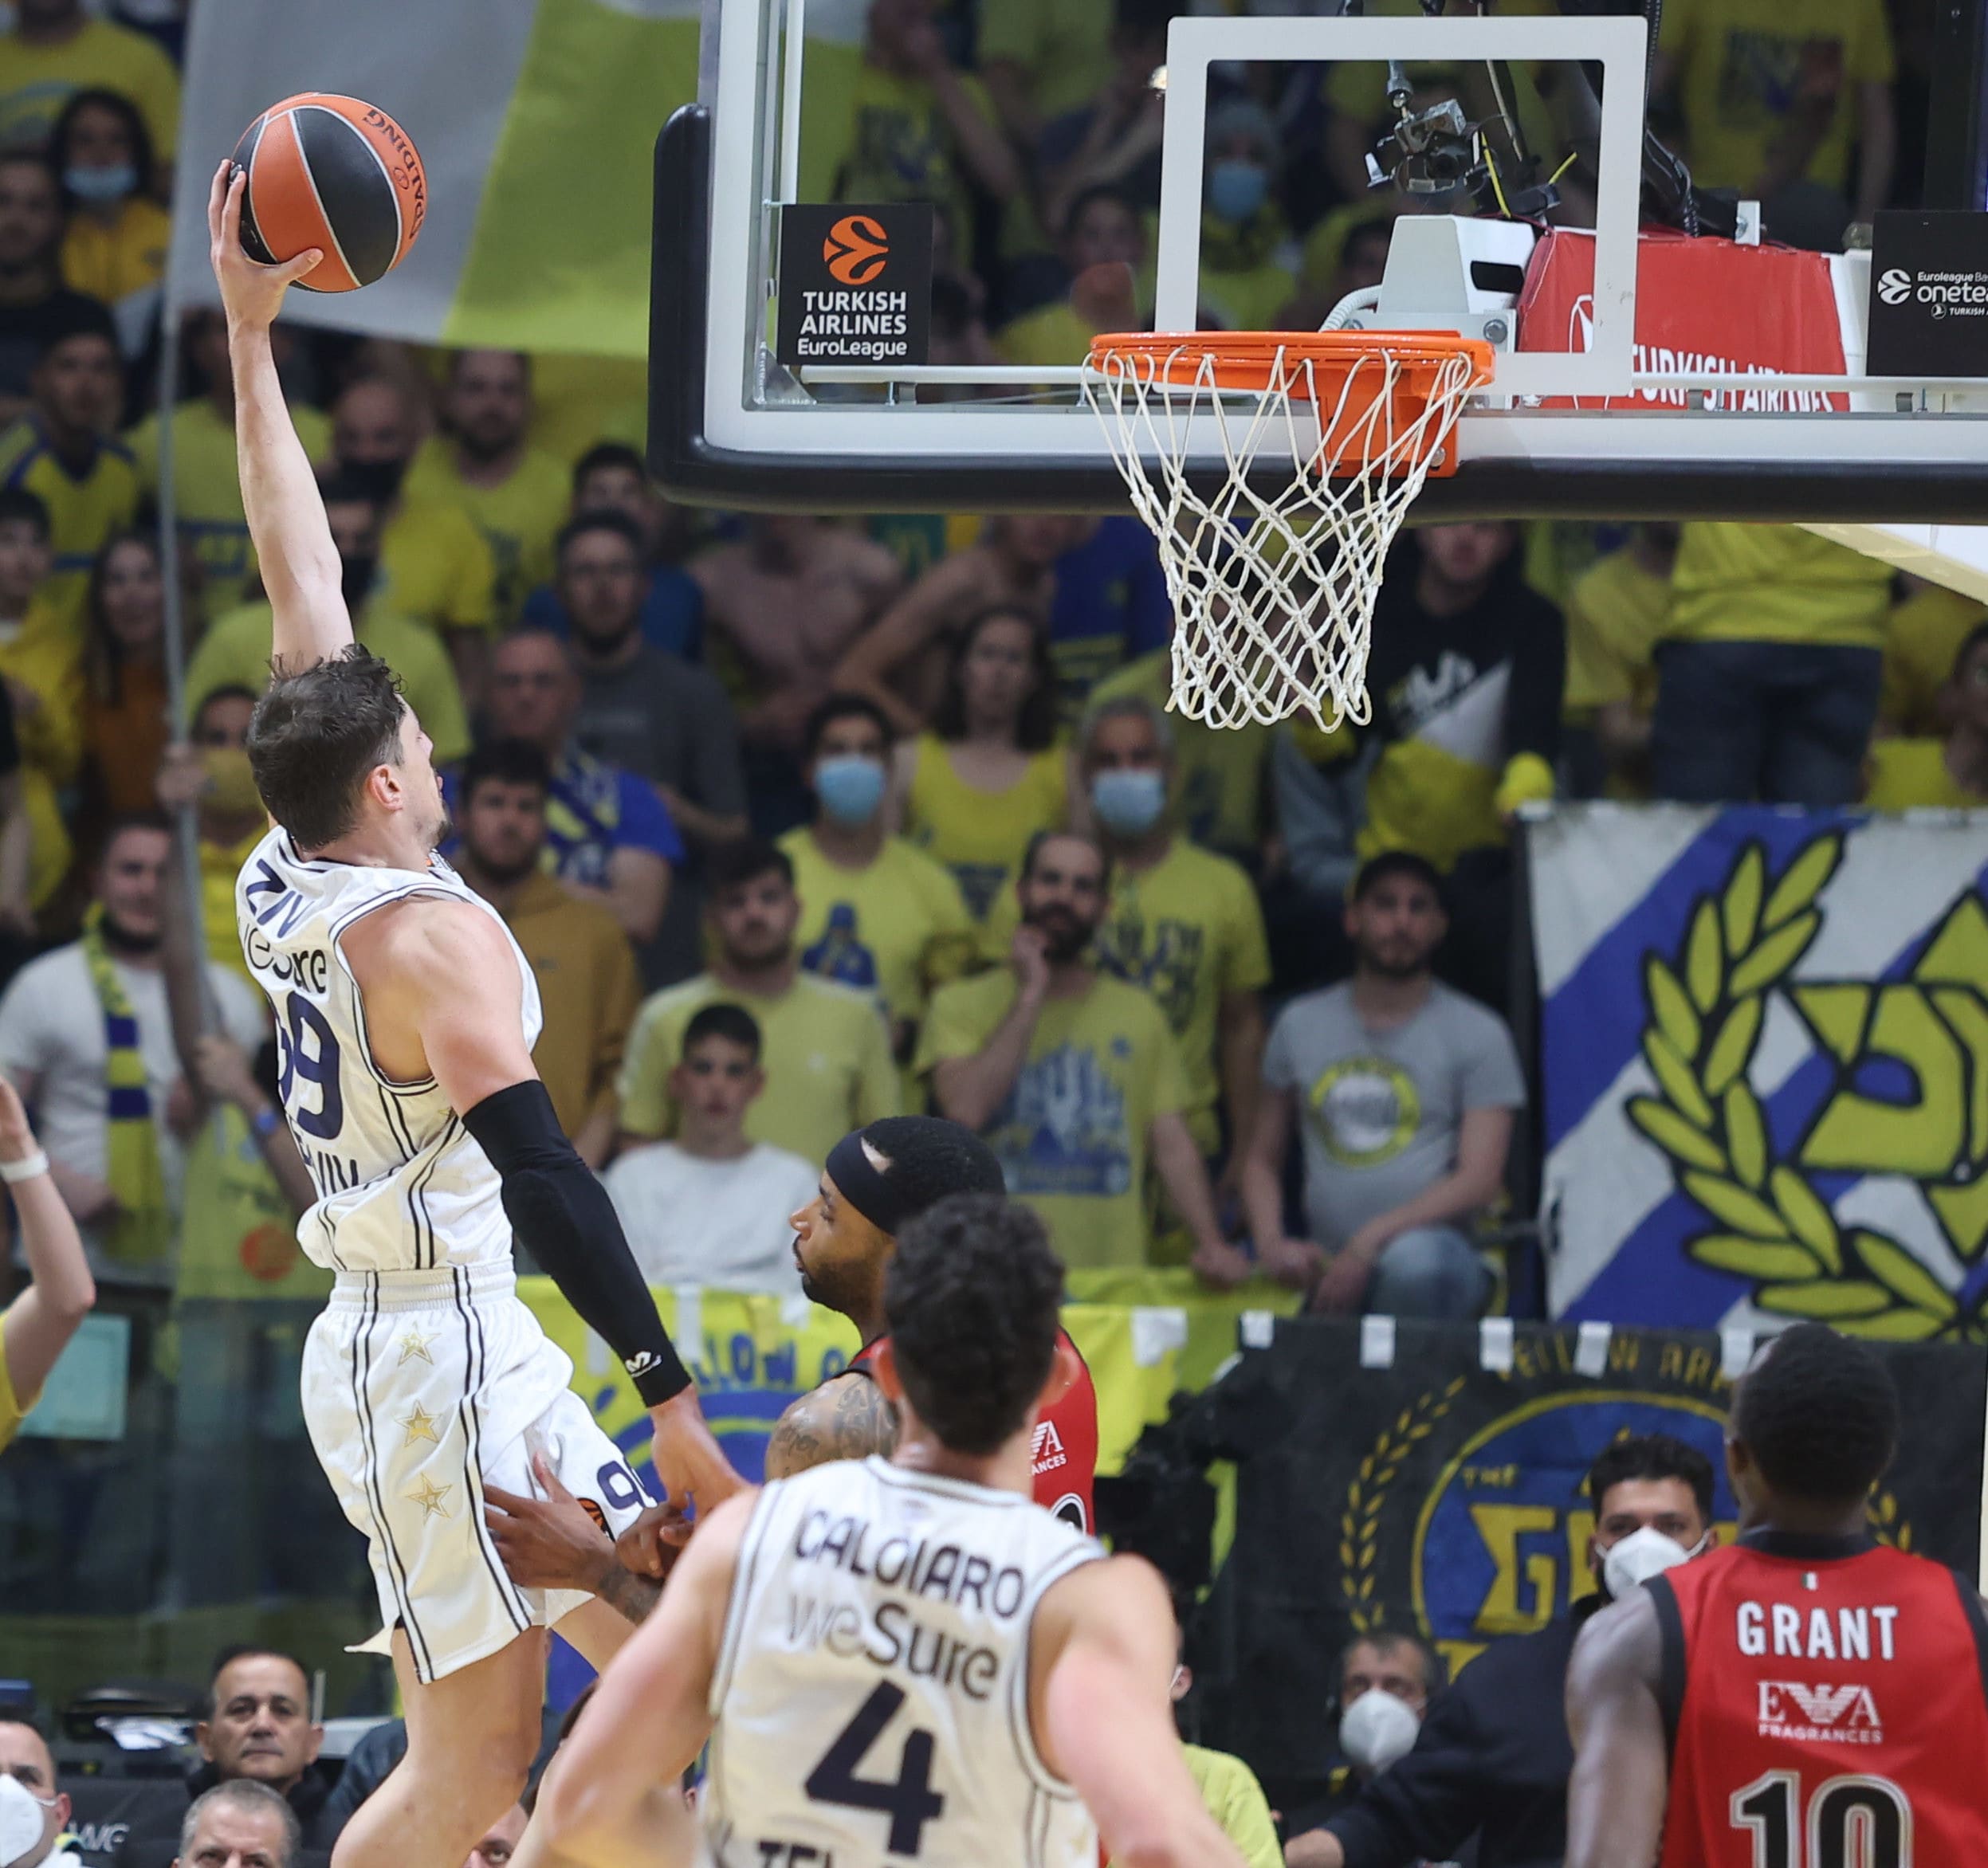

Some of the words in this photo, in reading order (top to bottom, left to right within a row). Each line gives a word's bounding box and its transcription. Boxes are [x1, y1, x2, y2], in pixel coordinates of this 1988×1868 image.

[1917, 272, 1974, 285] Euroleague
[1974, 272, 1988, 282] Ba
[803, 292, 906, 312] TURKISH
[1917, 282, 1988, 303] onete
[1949, 307, 1985, 316] TURKISH
[800, 315, 907, 335] AIRLINES
[797, 338, 907, 360] EuroLeague
[1031, 1453, 1067, 1474] ANCES
[796, 1511, 1024, 1619] CALOIARO
[1736, 1600, 1899, 1660] GRANT
[1758, 1724, 1882, 1744] FRAGRANCES
[803, 1678, 945, 1856] 4
[1729, 1768, 1913, 1868] 10
